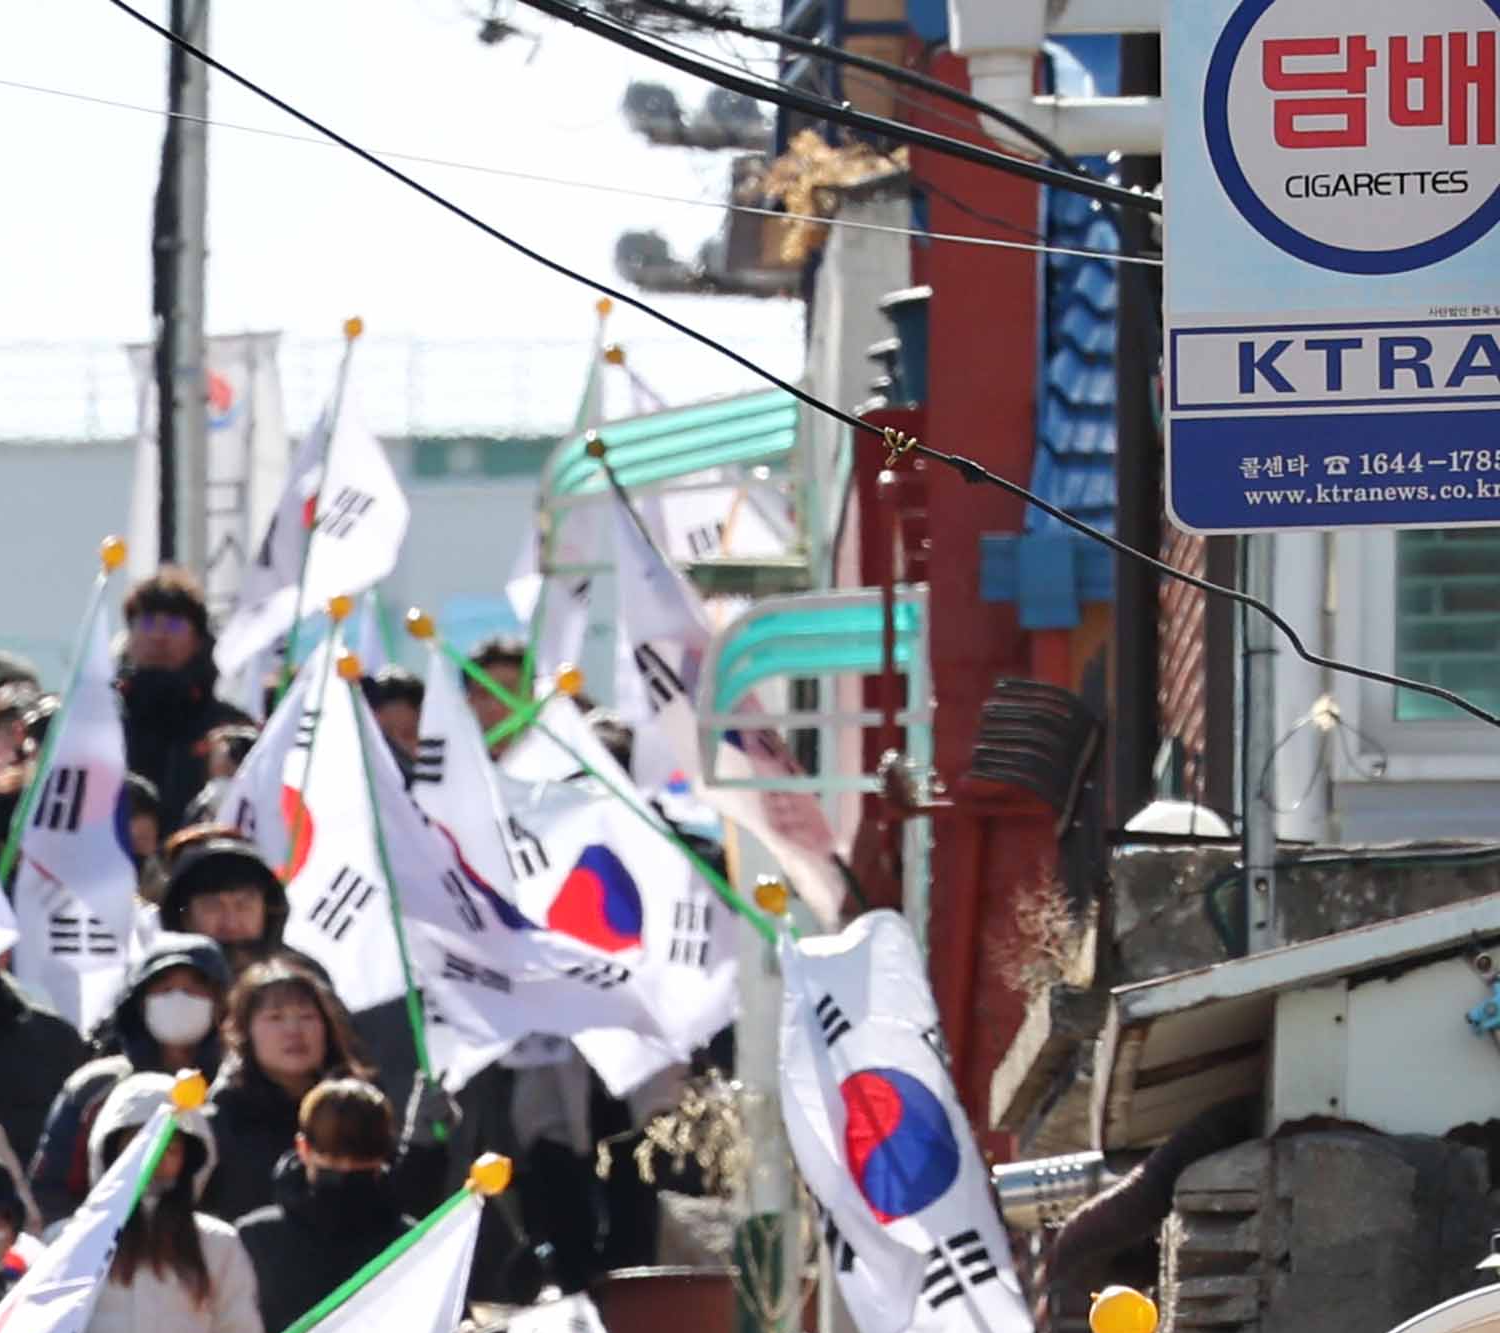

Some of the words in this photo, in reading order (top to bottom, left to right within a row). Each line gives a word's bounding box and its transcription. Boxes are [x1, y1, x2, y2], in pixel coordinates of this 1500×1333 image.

[1262, 31, 1497, 149] 담배
[1284, 170, 1469, 199] CIGARETTES
[1238, 333, 1500, 394] KTRA
[1238, 454, 1309, 479] 콜센타
